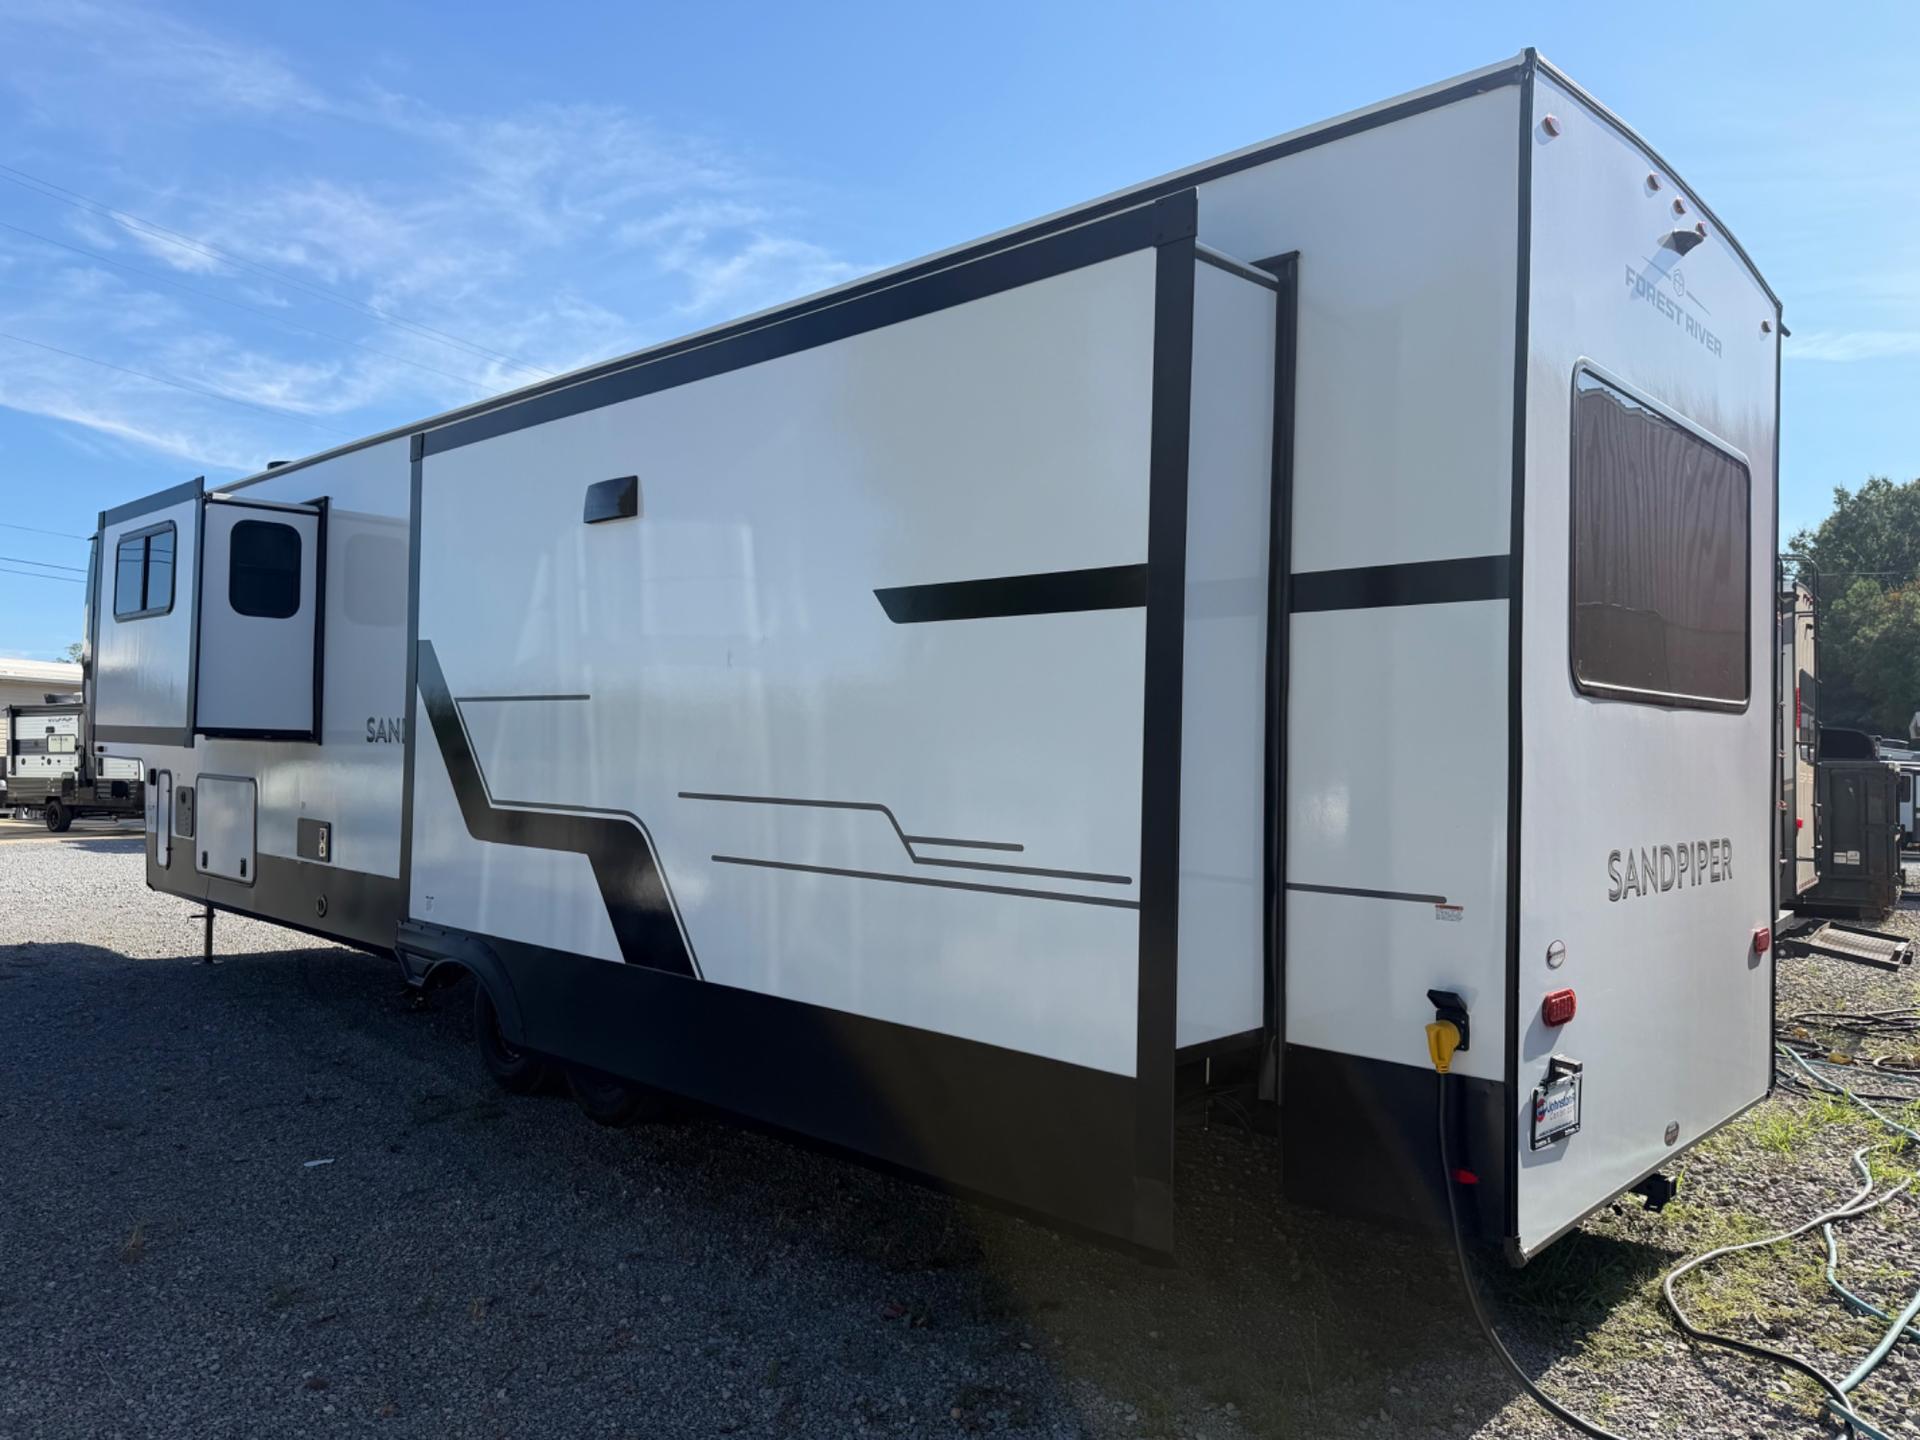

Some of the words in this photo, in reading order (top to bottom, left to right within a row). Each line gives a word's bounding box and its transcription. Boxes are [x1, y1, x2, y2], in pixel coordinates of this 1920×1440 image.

[1625, 263, 1684, 325] FOREST
[1685, 313, 1723, 359] RIVER
[1607, 837, 1733, 902] SANDPIPER
